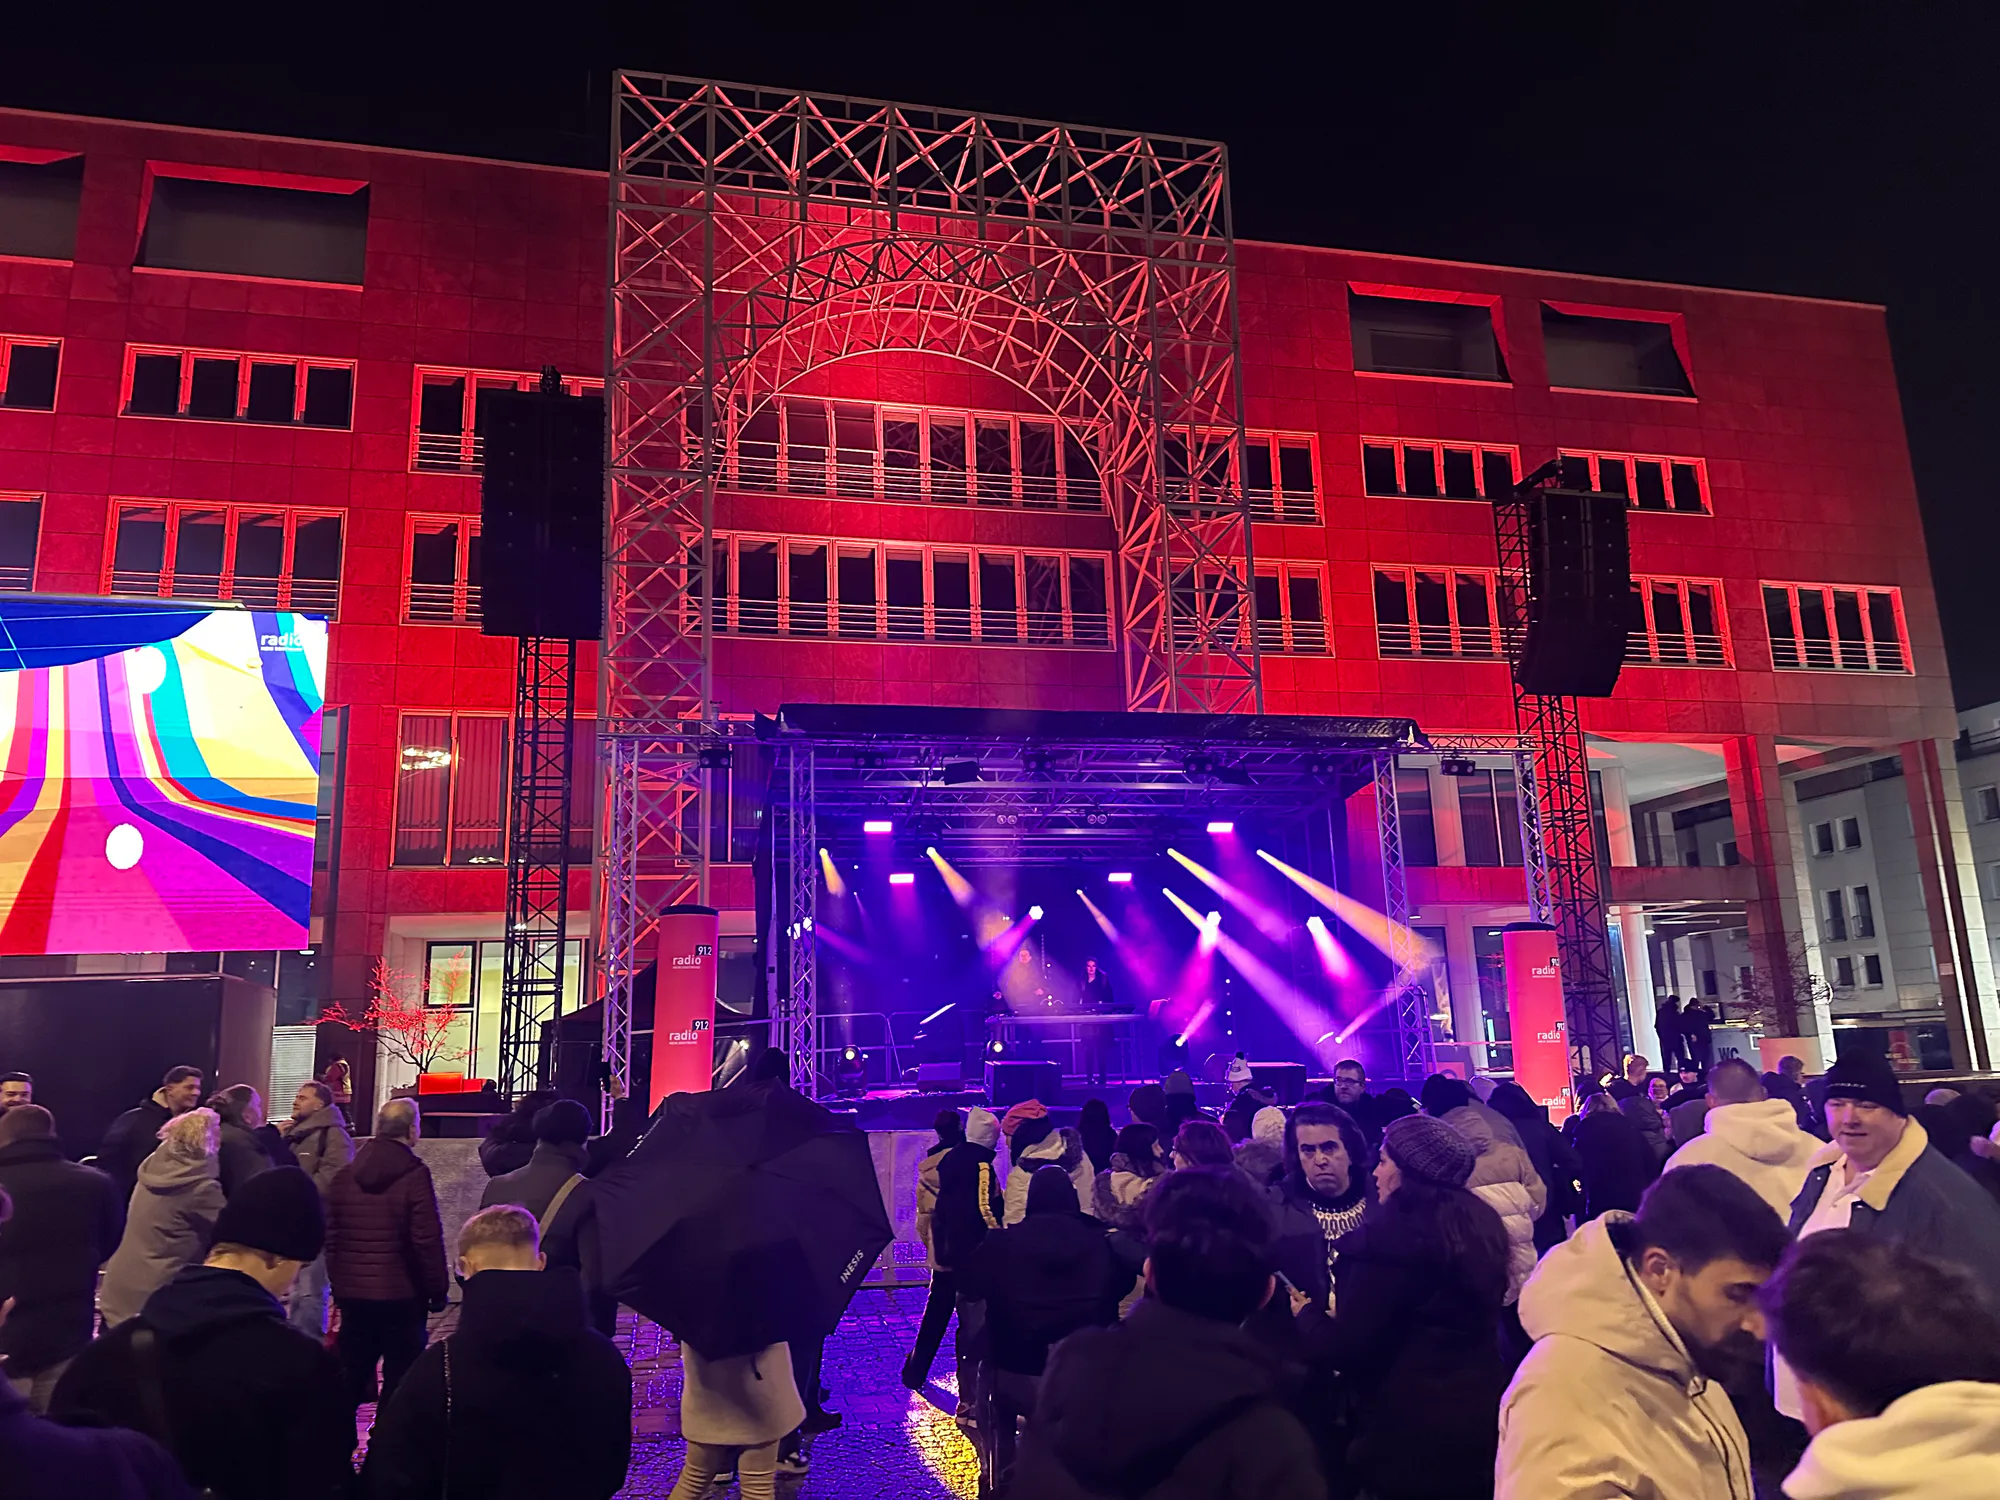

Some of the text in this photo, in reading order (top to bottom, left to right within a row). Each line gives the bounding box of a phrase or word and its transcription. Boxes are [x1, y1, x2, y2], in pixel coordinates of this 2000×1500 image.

[672, 954, 702, 965] radio
[1532, 966, 1555, 974] radio
[669, 1030, 698, 1041] radio
[1537, 1030, 1560, 1040] radio
[1718, 1047, 1739, 1060] WC
[1542, 1096, 1566, 1106] radio
[840, 1249, 864, 1283] INESIS
